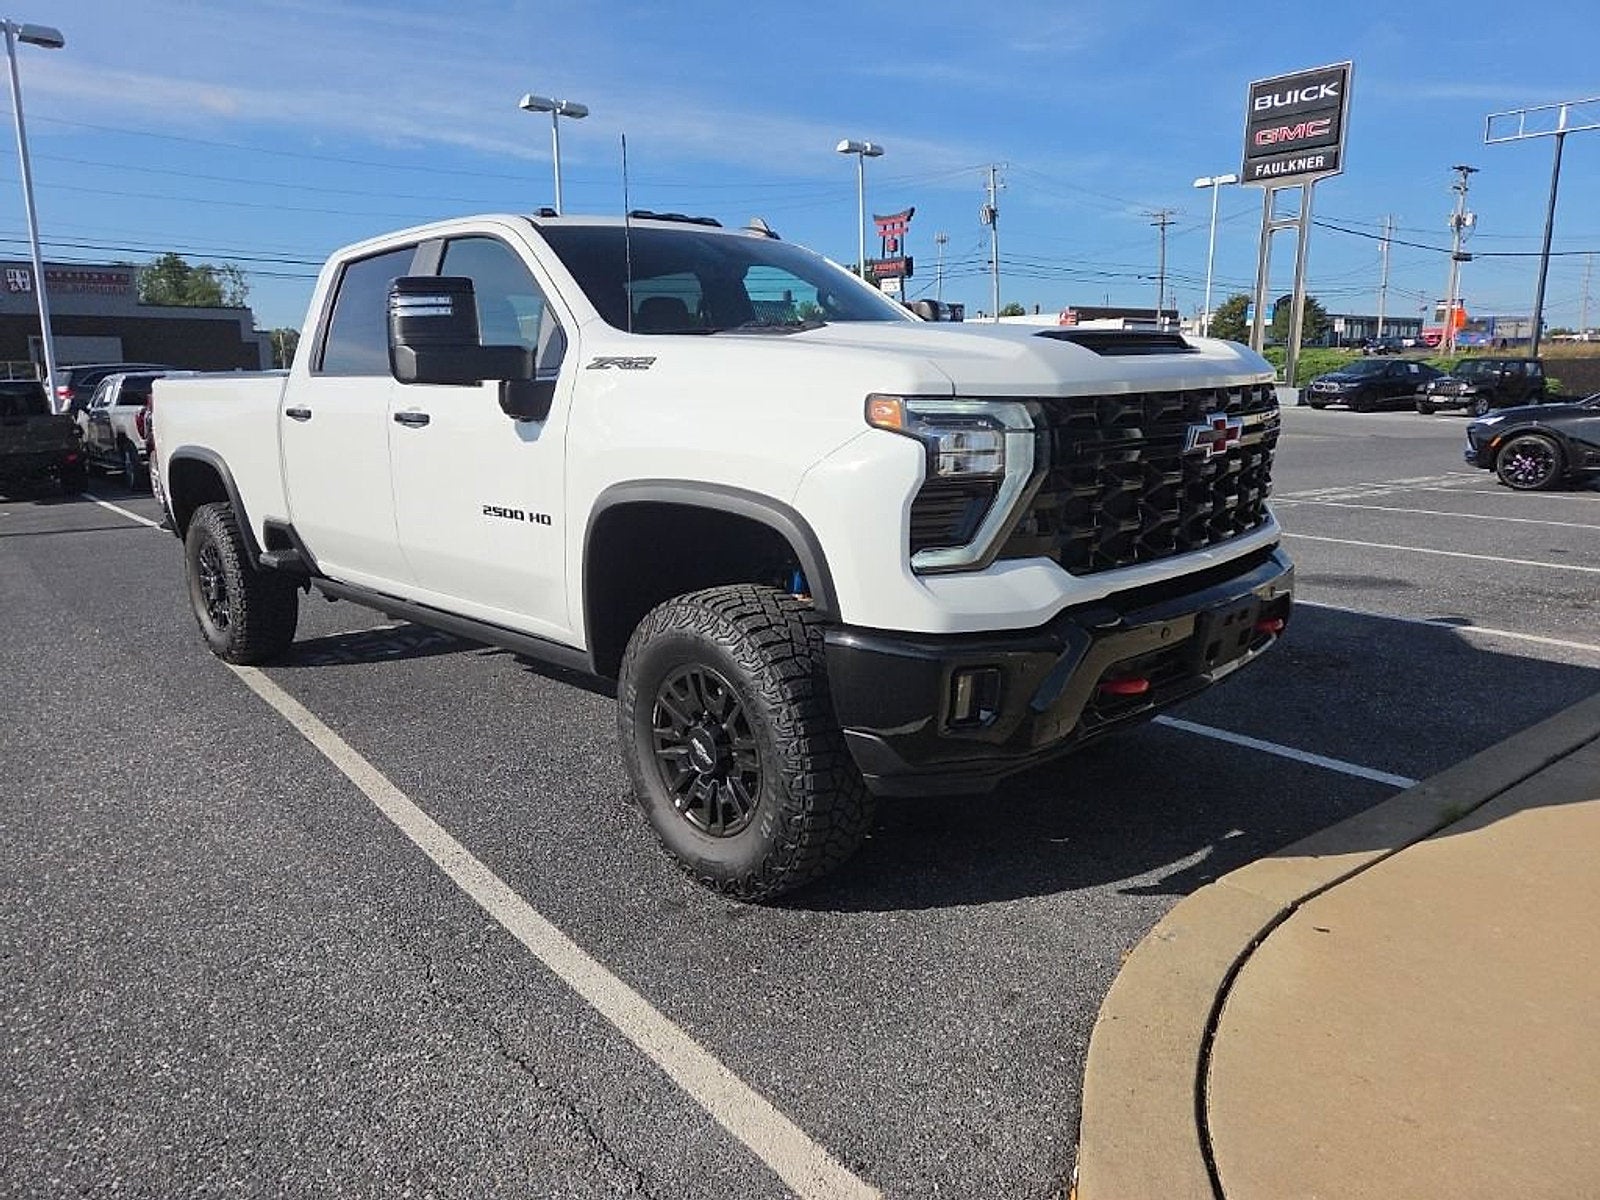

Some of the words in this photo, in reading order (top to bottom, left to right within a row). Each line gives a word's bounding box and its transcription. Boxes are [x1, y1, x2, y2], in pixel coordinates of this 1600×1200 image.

[1254, 82, 1339, 111] BUICK
[1255, 118, 1331, 145] GMC
[1255, 156, 1325, 176] FAULKNER
[586, 356, 657, 370] ZR2
[483, 504, 525, 521] 2500
[529, 512, 552, 526] HD
